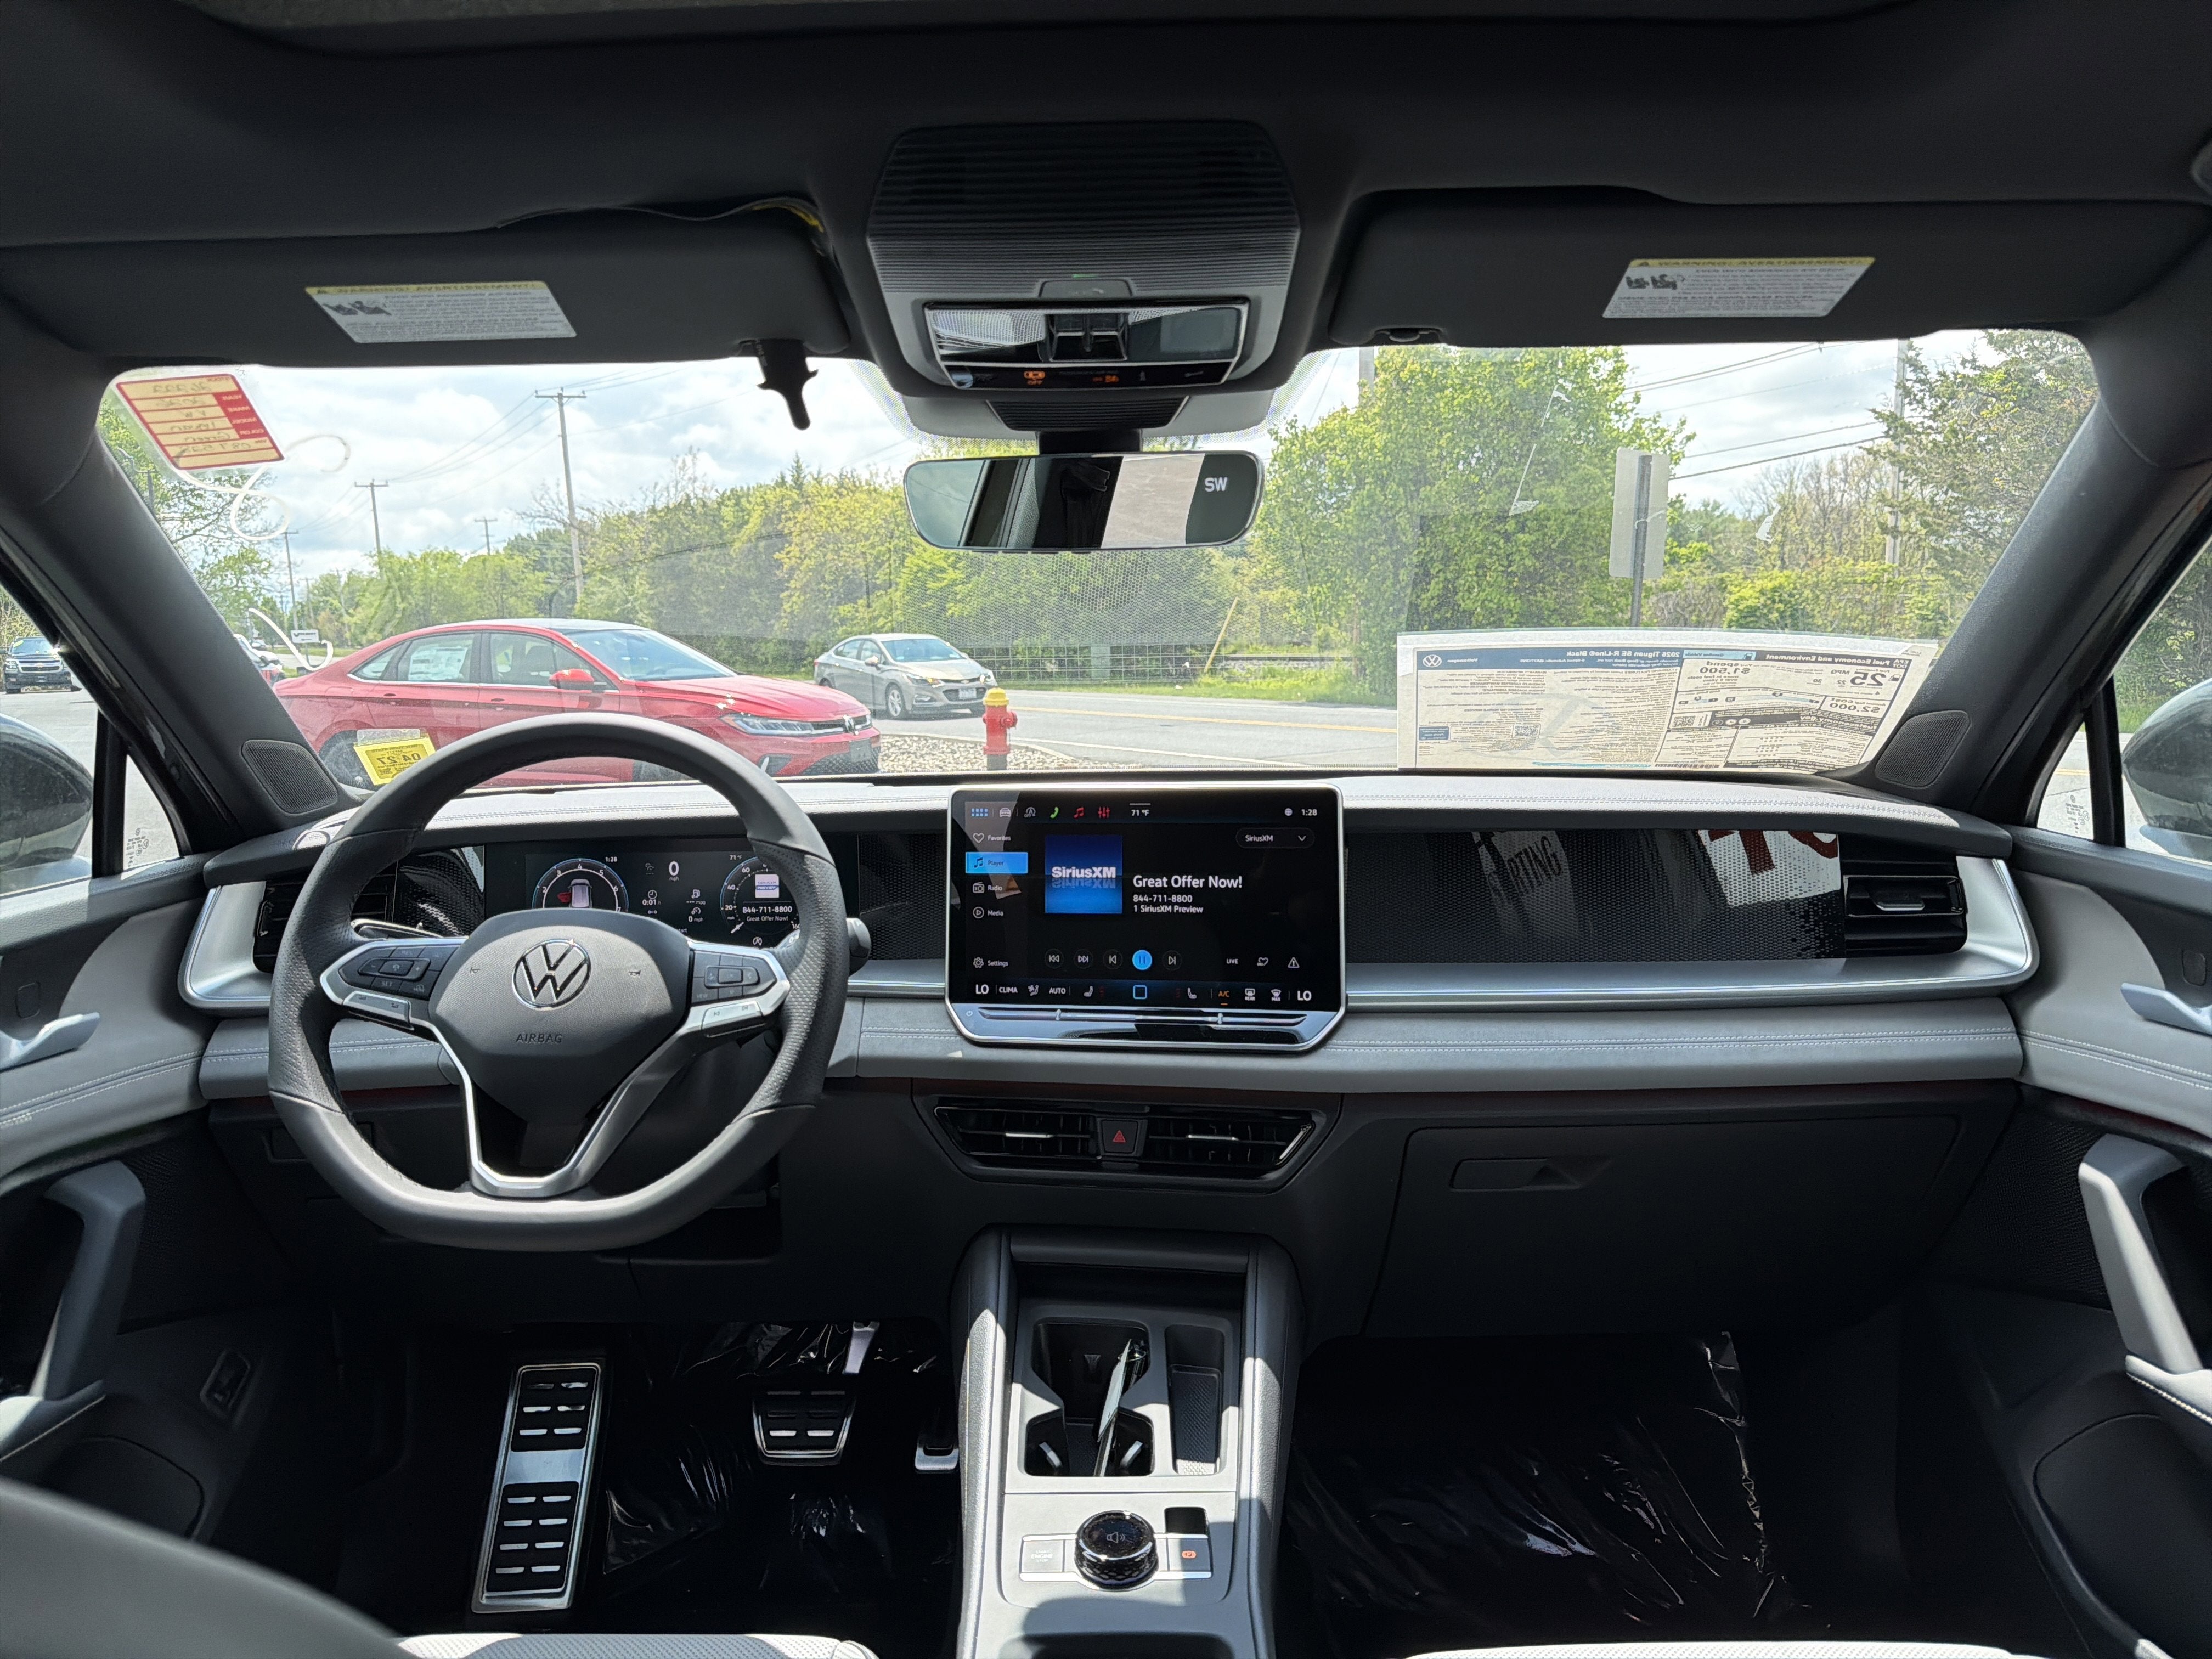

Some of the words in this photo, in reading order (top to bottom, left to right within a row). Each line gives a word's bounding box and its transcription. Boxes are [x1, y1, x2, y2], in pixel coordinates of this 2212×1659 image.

[1205, 477, 1228, 493] SW
[1301, 809, 1318, 817] 1:28
[1245, 834, 1274, 843] SiriusXM
[668, 860, 680, 876] 0
[1051, 866, 1117, 879] SiriusXM
[1132, 875, 1169, 889] Great
[1171, 875, 1205, 889] Offer
[1208, 875, 1243, 889] Now!
[1132, 894, 1193, 904] 844-711-8800
[742, 906, 793, 915] 844-711-8800
[1133, 905, 1138, 913] 1
[1139, 905, 1172, 913] SiriusXM
[1173, 905, 1204, 914] Preview
[987, 960, 1009, 968] Settings
[975, 984, 989, 995] LO
[1217, 990, 1230, 998] A/C
[1297, 990, 1312, 1002] LO
[515, 1033, 563, 1044] AIRBAG
